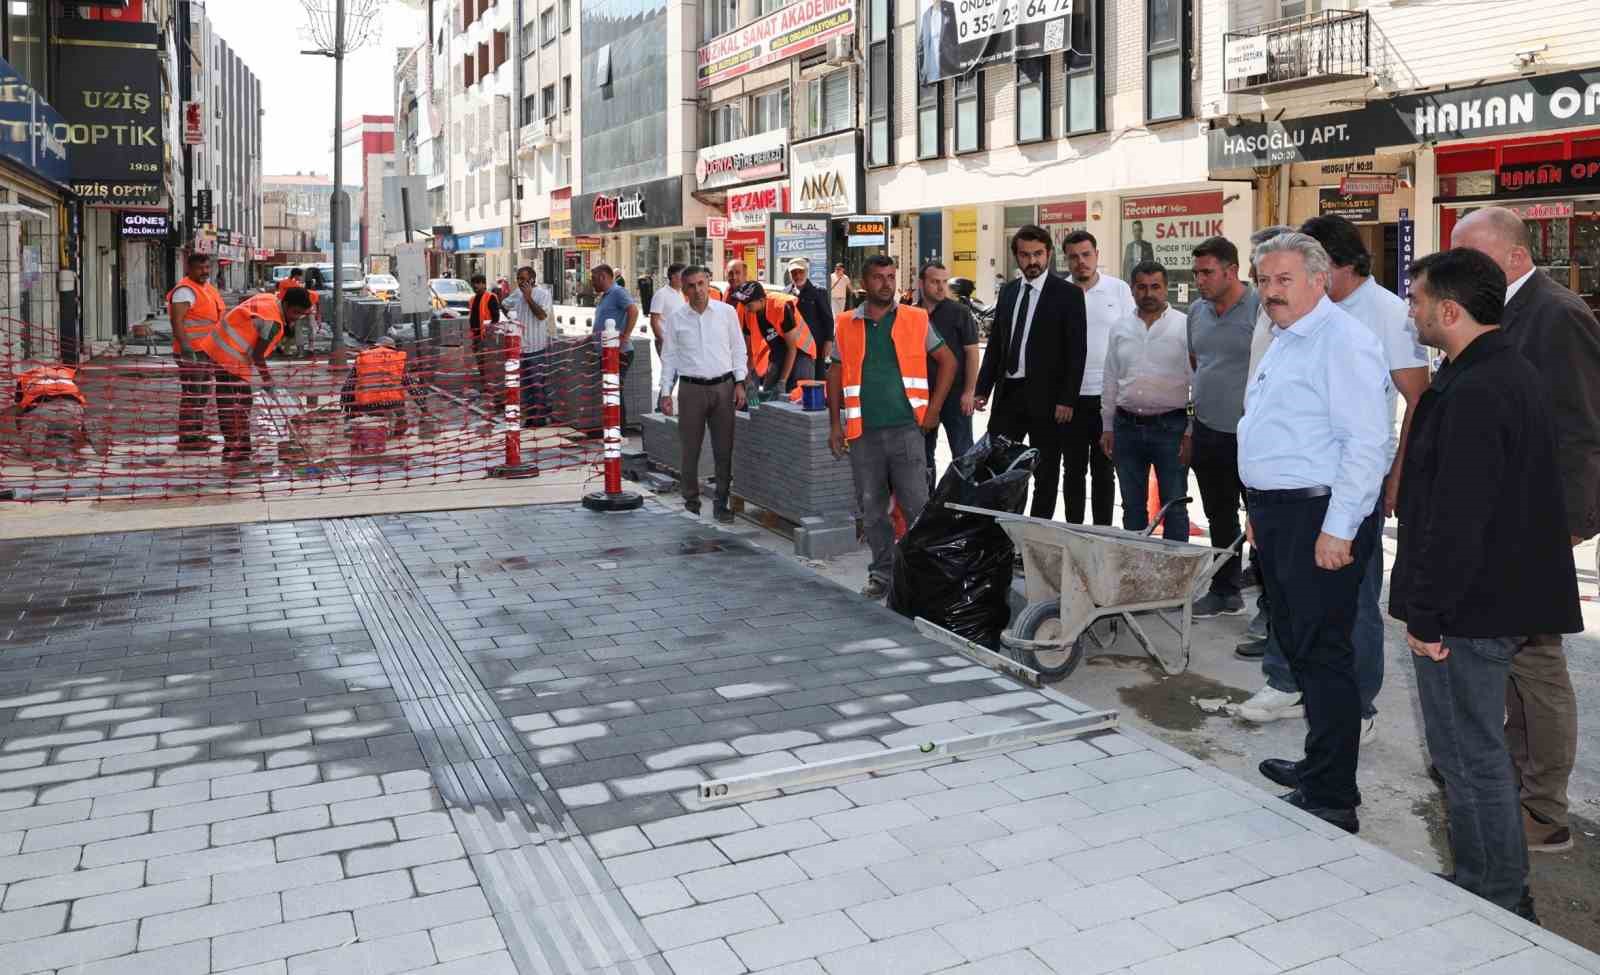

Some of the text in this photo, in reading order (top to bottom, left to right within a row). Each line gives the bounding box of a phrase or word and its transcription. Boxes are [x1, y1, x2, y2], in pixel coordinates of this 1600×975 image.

[743, 18, 778, 46] SANAT
[960, 21, 967, 37] 0
[973, 13, 996, 34] 352
[1026, 0, 1046, 17] 64
[81, 85, 150, 114] UZİŞ
[1415, 92, 1534, 135] HAKAN
[70, 119, 157, 146] OPTİK
[1223, 124, 1350, 155] HASOĞLU APT.
[74, 182, 157, 198] UZİŞ OPTİ
[800, 169, 845, 201] ANKA
[1501, 167, 1562, 186] HAKAN
[125, 215, 166, 226] GÜNEŞ
[1156, 219, 1223, 239] SATILIK
